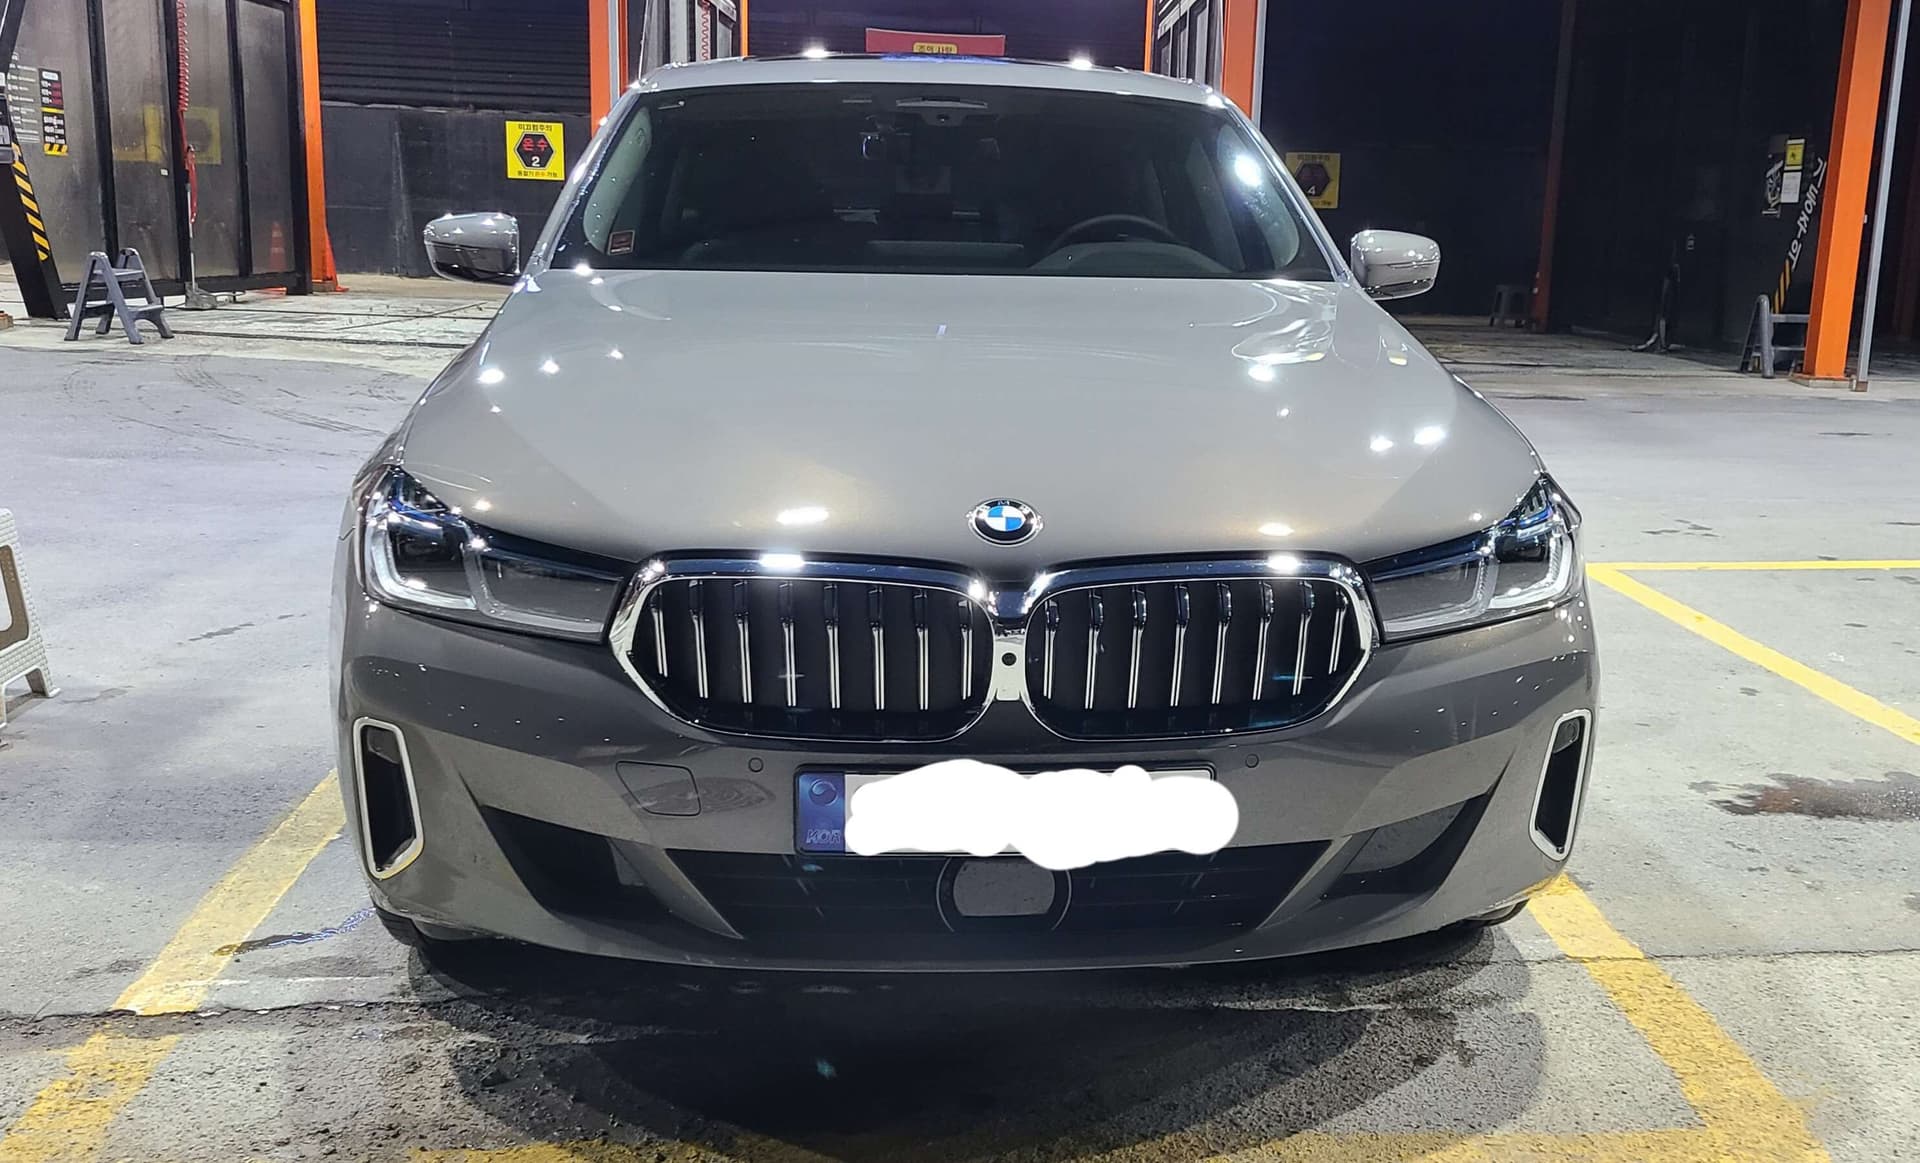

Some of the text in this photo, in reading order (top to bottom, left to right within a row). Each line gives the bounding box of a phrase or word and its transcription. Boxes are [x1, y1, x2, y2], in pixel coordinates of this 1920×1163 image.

[531, 156, 540, 167] 2
[1307, 185, 1316, 195] 4
[806, 829, 841, 844] KOR
